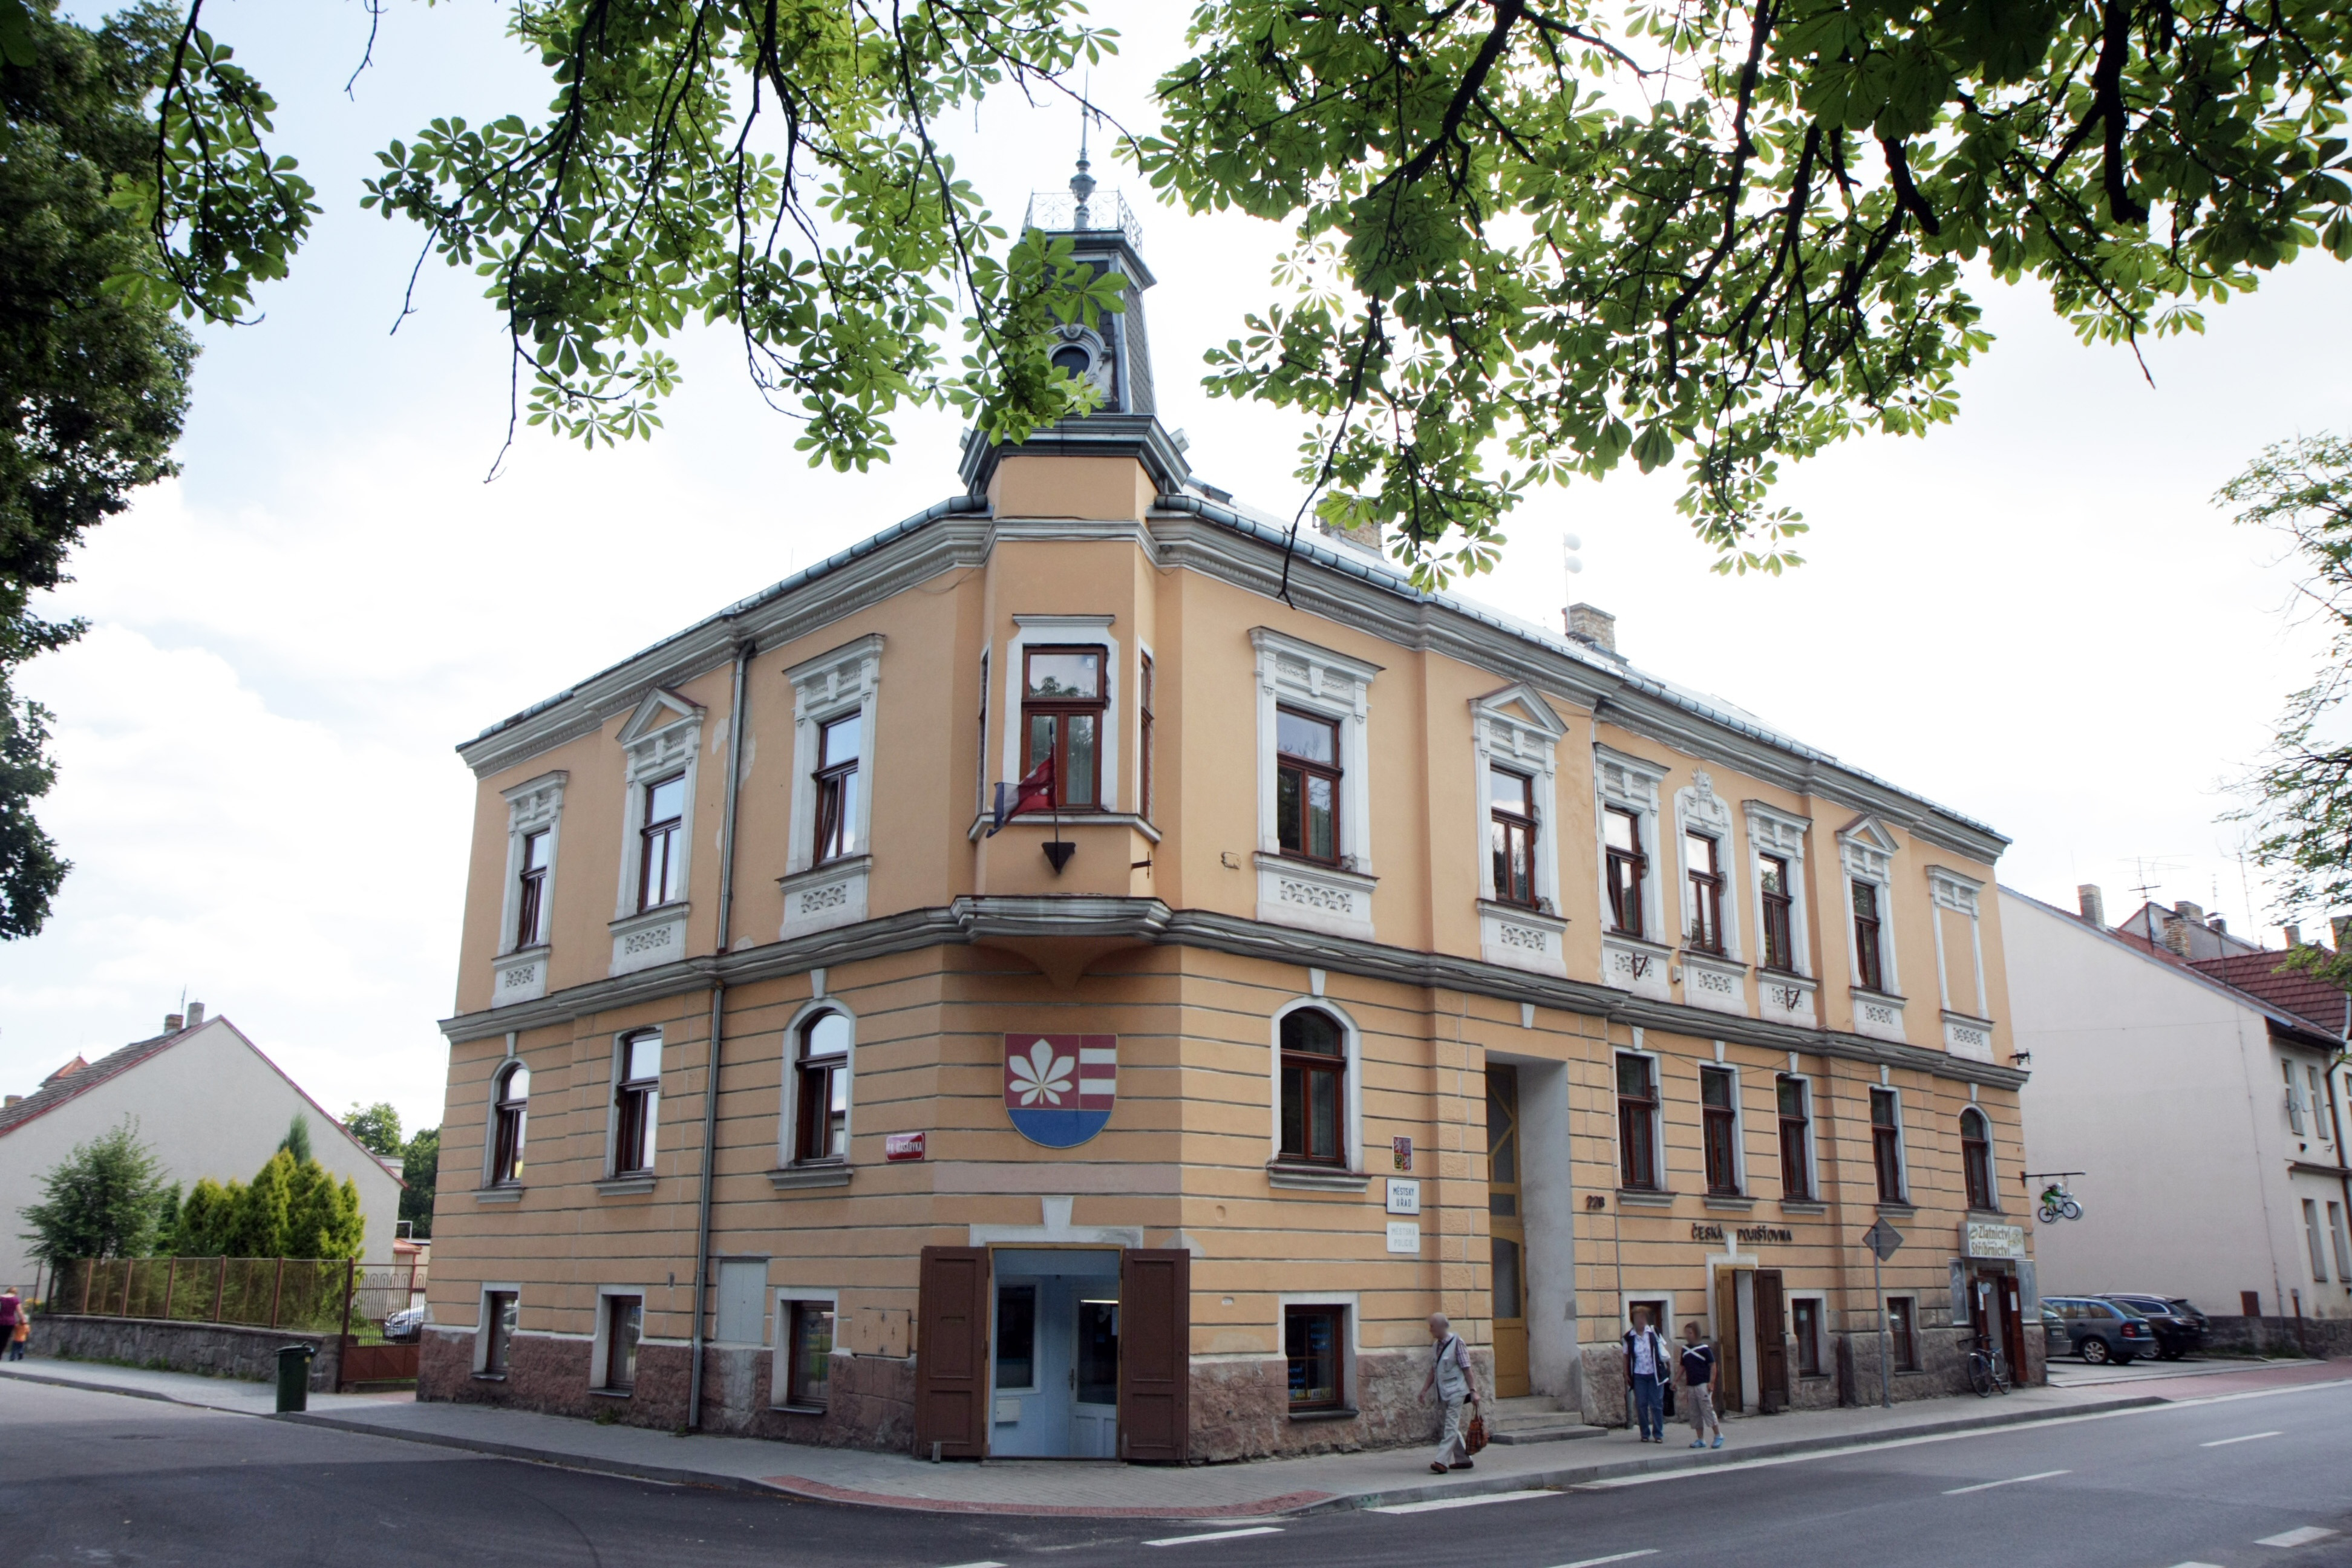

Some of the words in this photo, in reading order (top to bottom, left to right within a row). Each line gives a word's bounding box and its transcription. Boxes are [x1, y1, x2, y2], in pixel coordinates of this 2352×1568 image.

[896, 1142, 922, 1152] MASARYKA
[1393, 1185, 1414, 1196] MĚSTSKÝ
[1391, 1226, 1416, 1235] MĚSTSKÁ
[1691, 1223, 1723, 1240] ČESKÁ
[1737, 1225, 1792, 1242] POJIŠŤOVNA
[1978, 1226, 2010, 1240] Zlatnictví
[1394, 1238, 1414, 1247] POLICIE
[1971, 1241, 2011, 1257] Stříbrnictví
